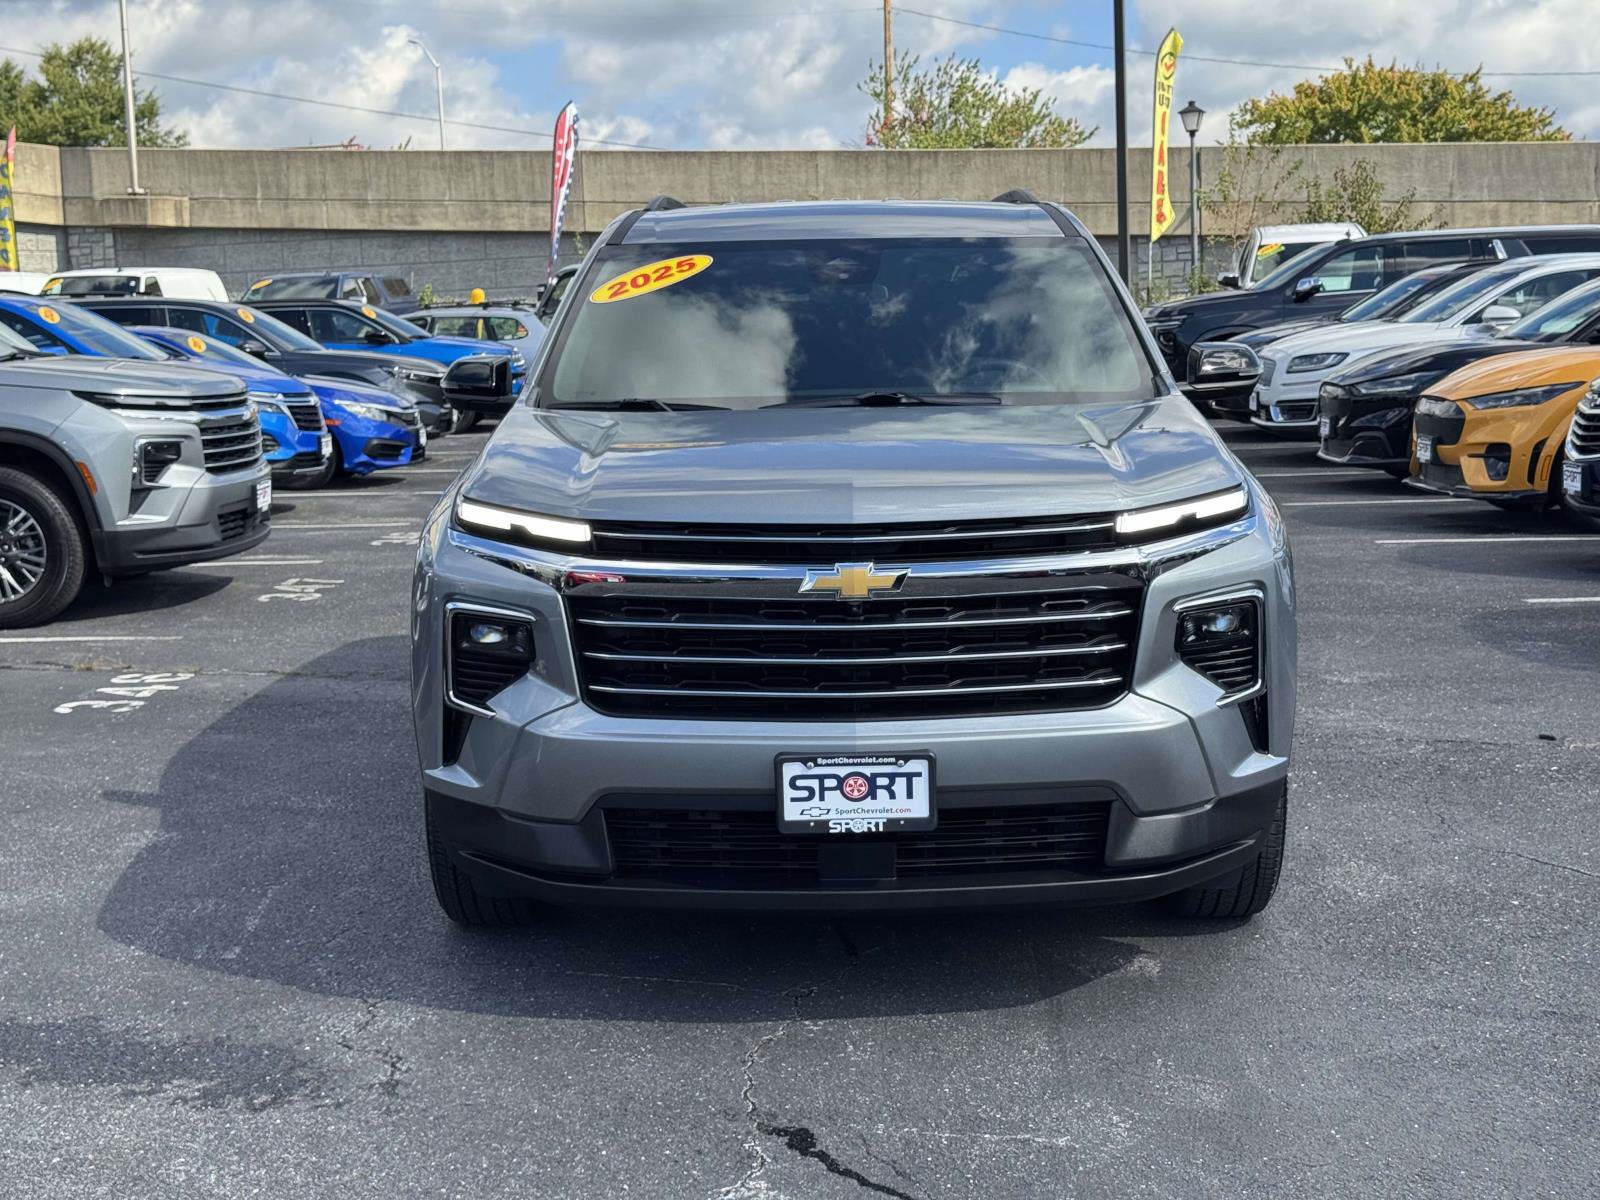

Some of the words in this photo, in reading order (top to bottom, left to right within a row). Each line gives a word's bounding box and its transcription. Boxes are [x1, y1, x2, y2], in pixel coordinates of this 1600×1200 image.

[607, 257, 696, 299] 2025
[816, 756, 896, 765] SportChevrolet.com
[788, 771, 922, 802] SPORT
[835, 807, 912, 815] SportChevrolet.com
[828, 819, 887, 833] SPORT
